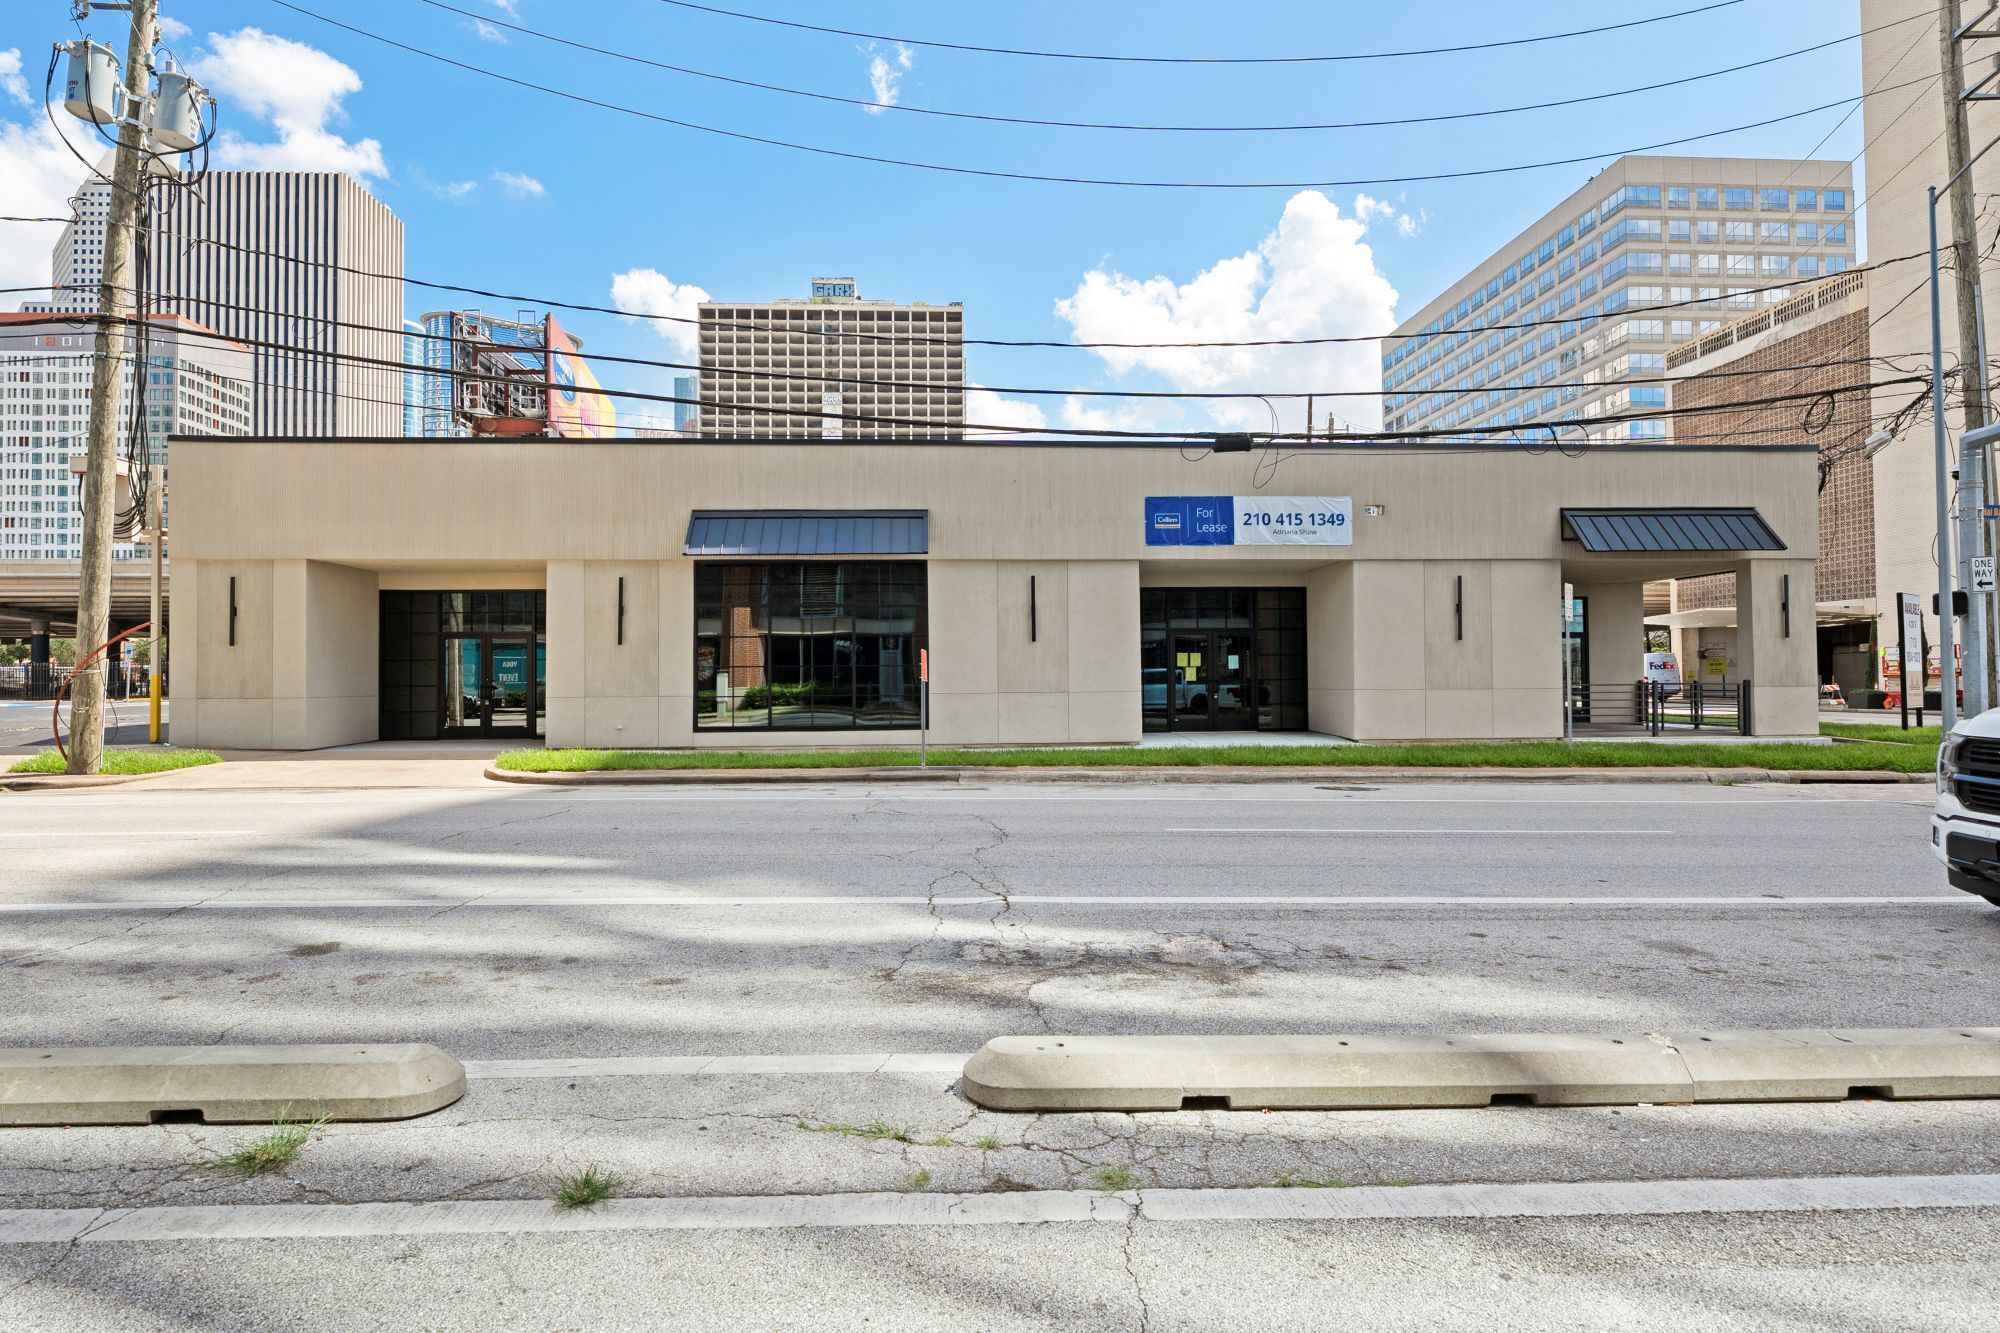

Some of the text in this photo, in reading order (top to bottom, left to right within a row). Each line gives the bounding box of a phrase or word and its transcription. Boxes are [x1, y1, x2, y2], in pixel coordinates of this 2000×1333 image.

[1196, 507, 1214, 518] For
[1243, 512, 1345, 526] 210 415 1349
[1196, 522, 1228, 533] Lease
[1974, 559, 1993, 568] ONE
[1974, 569, 1993, 578] WAY
[1649, 661, 1675, 670] FedEx
